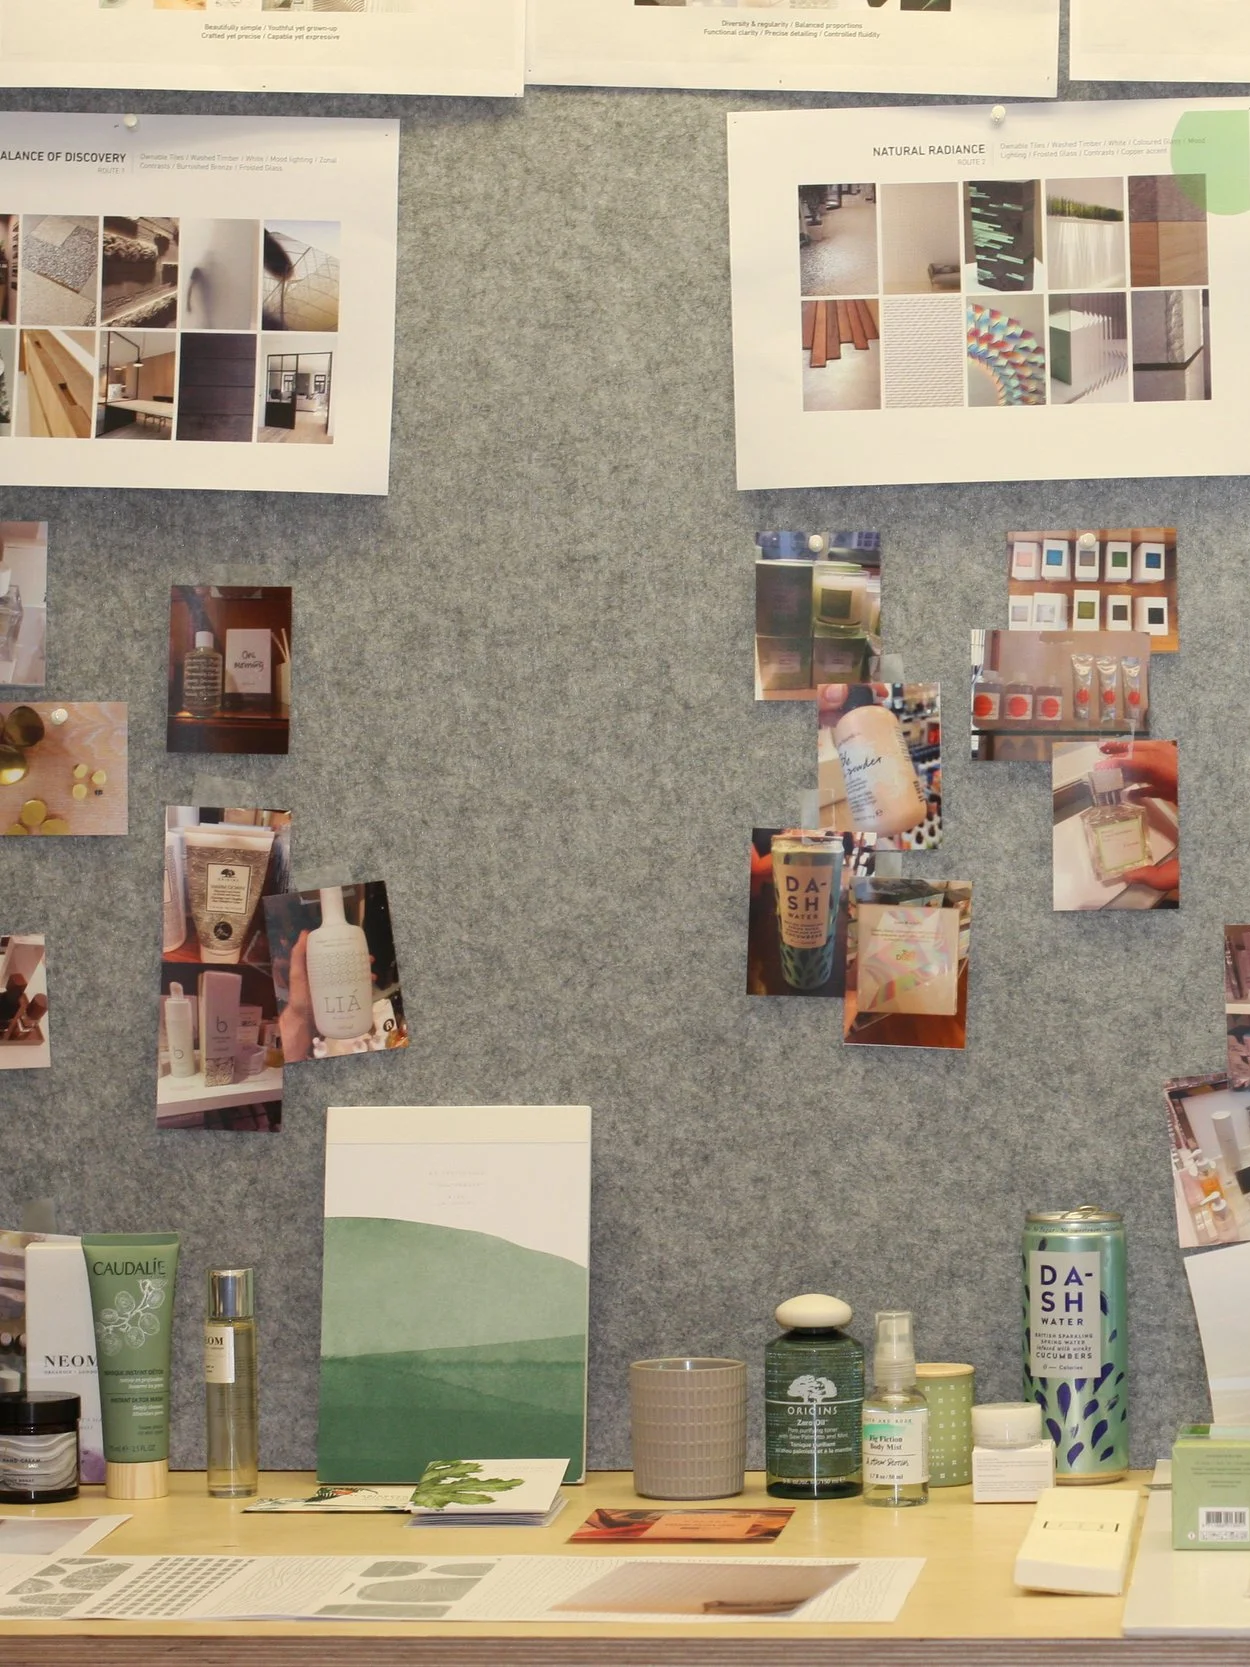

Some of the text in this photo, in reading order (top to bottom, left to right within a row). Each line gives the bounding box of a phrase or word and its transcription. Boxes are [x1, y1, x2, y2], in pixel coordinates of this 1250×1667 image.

[872, 144, 986, 157] NATURAL RADIANCE
[47, 151, 62, 162] OF
[65, 152, 126, 163] DISCOVERY
[1041, 1317, 1084, 1326] WATER
[1036, 1352, 1093, 1360] CUCUMBERS
